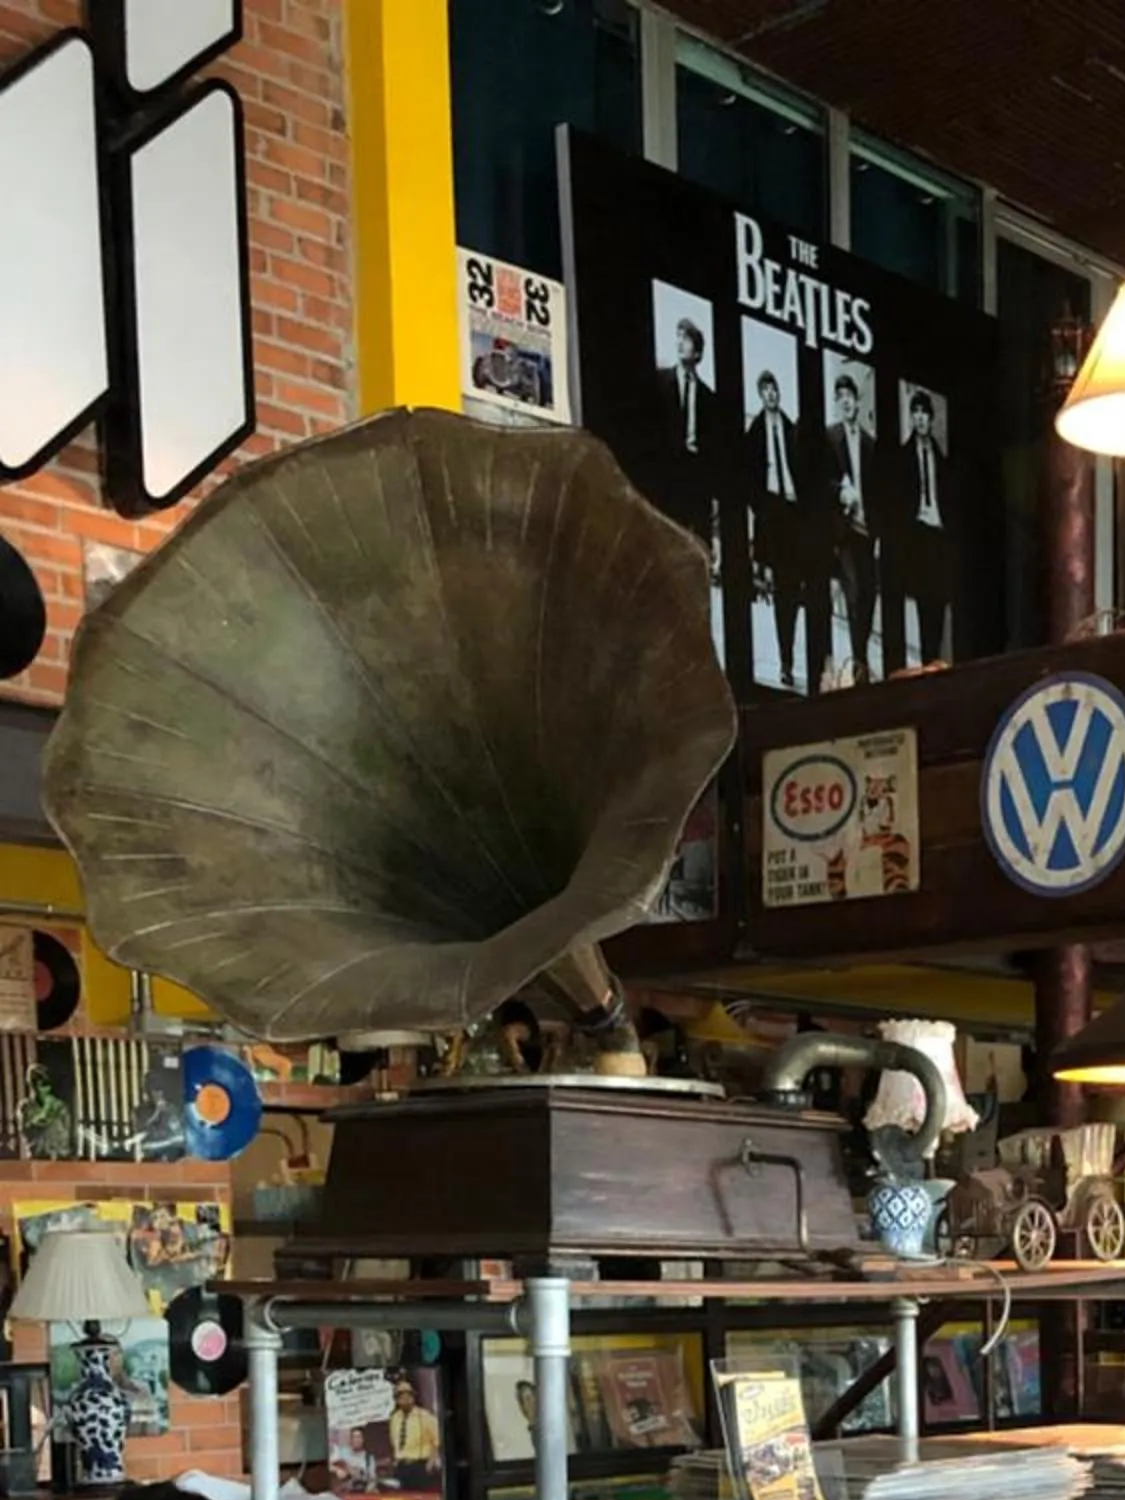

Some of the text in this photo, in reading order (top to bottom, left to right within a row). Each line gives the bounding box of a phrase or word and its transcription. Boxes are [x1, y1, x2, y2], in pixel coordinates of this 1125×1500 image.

[788, 234, 819, 269] THE
[524, 277, 550, 326] 32
[733, 210, 874, 354] BEATLES
